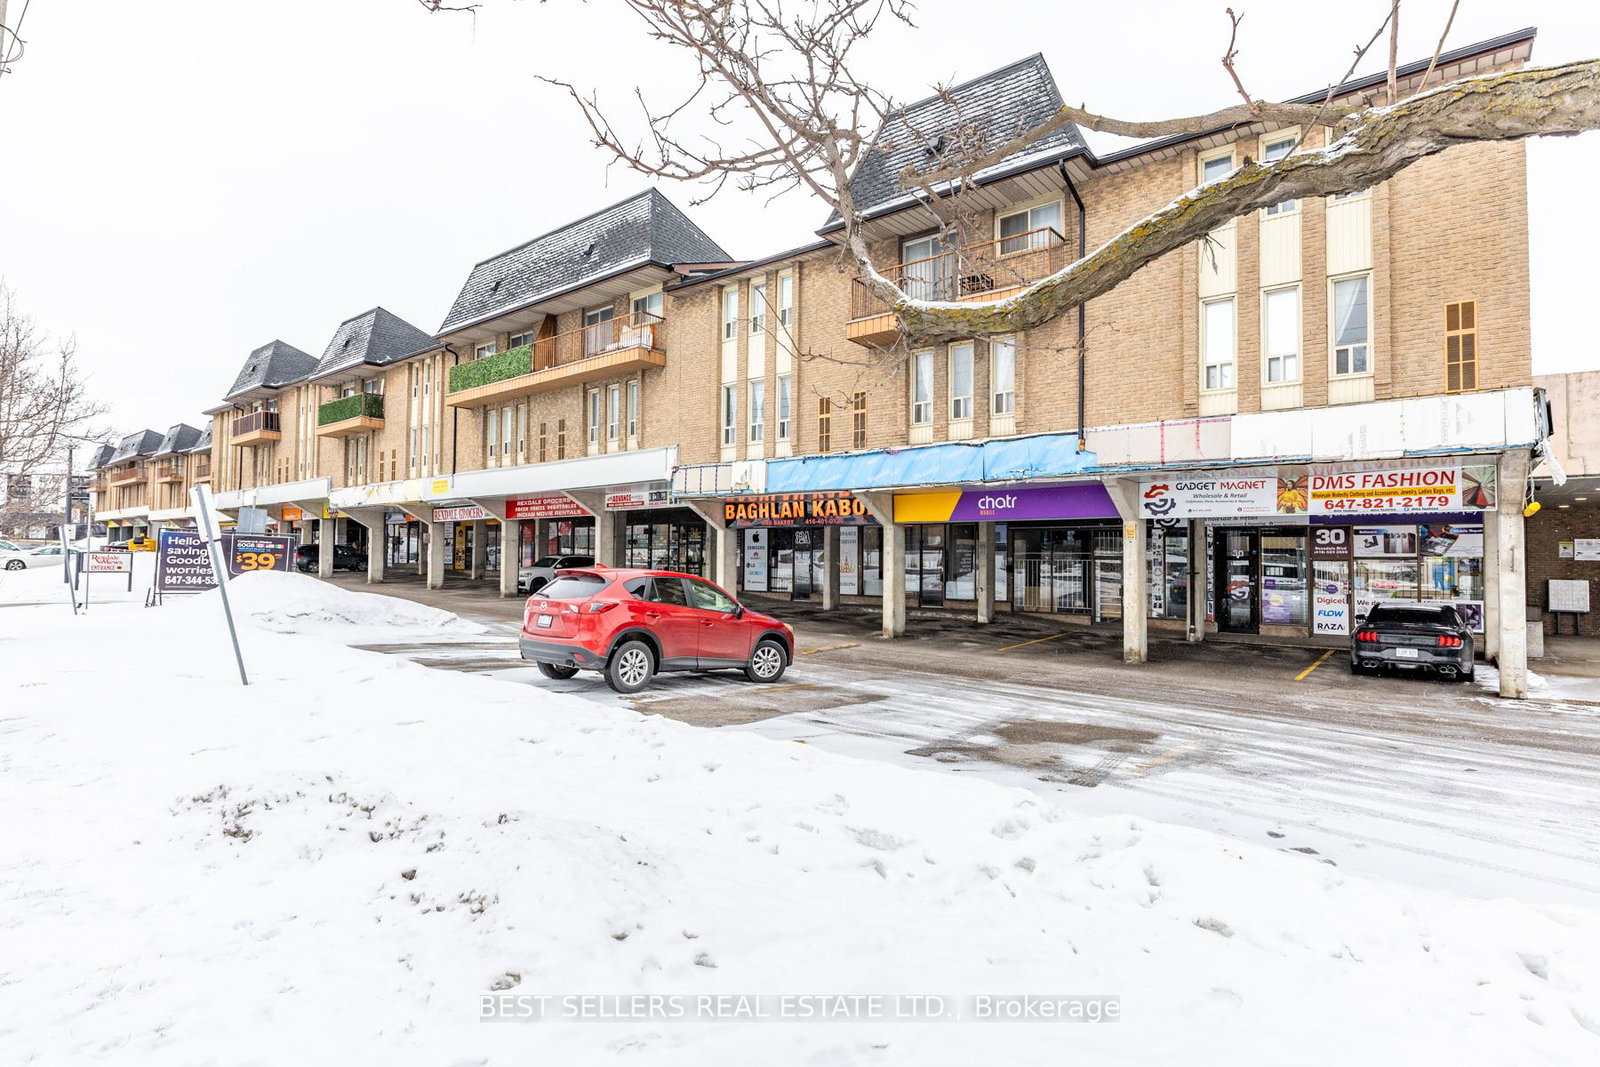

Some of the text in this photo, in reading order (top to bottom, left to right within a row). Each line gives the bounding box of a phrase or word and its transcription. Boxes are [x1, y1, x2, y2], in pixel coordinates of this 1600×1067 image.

[1175, 480, 1266, 491] GADGET MAGNET
[1312, 470, 1455, 490] DMS FASHION
[1349, 490, 1366, 498] Clothing
[978, 494, 1018, 509] chatr
[1324, 496, 1449, 510] 647-821-2179
[434, 508, 458, 521] REXDALE
[725, 500, 805, 520] BAGHLAN
[168, 536, 200, 546] Hello
[1316, 529, 1346, 545] 30
[167, 548, 208, 557] saving
[166, 556, 211, 565] Goodb
[236, 552, 276, 570] $39
[166, 566, 213, 574] worries
[164, 576, 218, 584] 647-344-53
[1317, 622, 1344, 631] RAZA
